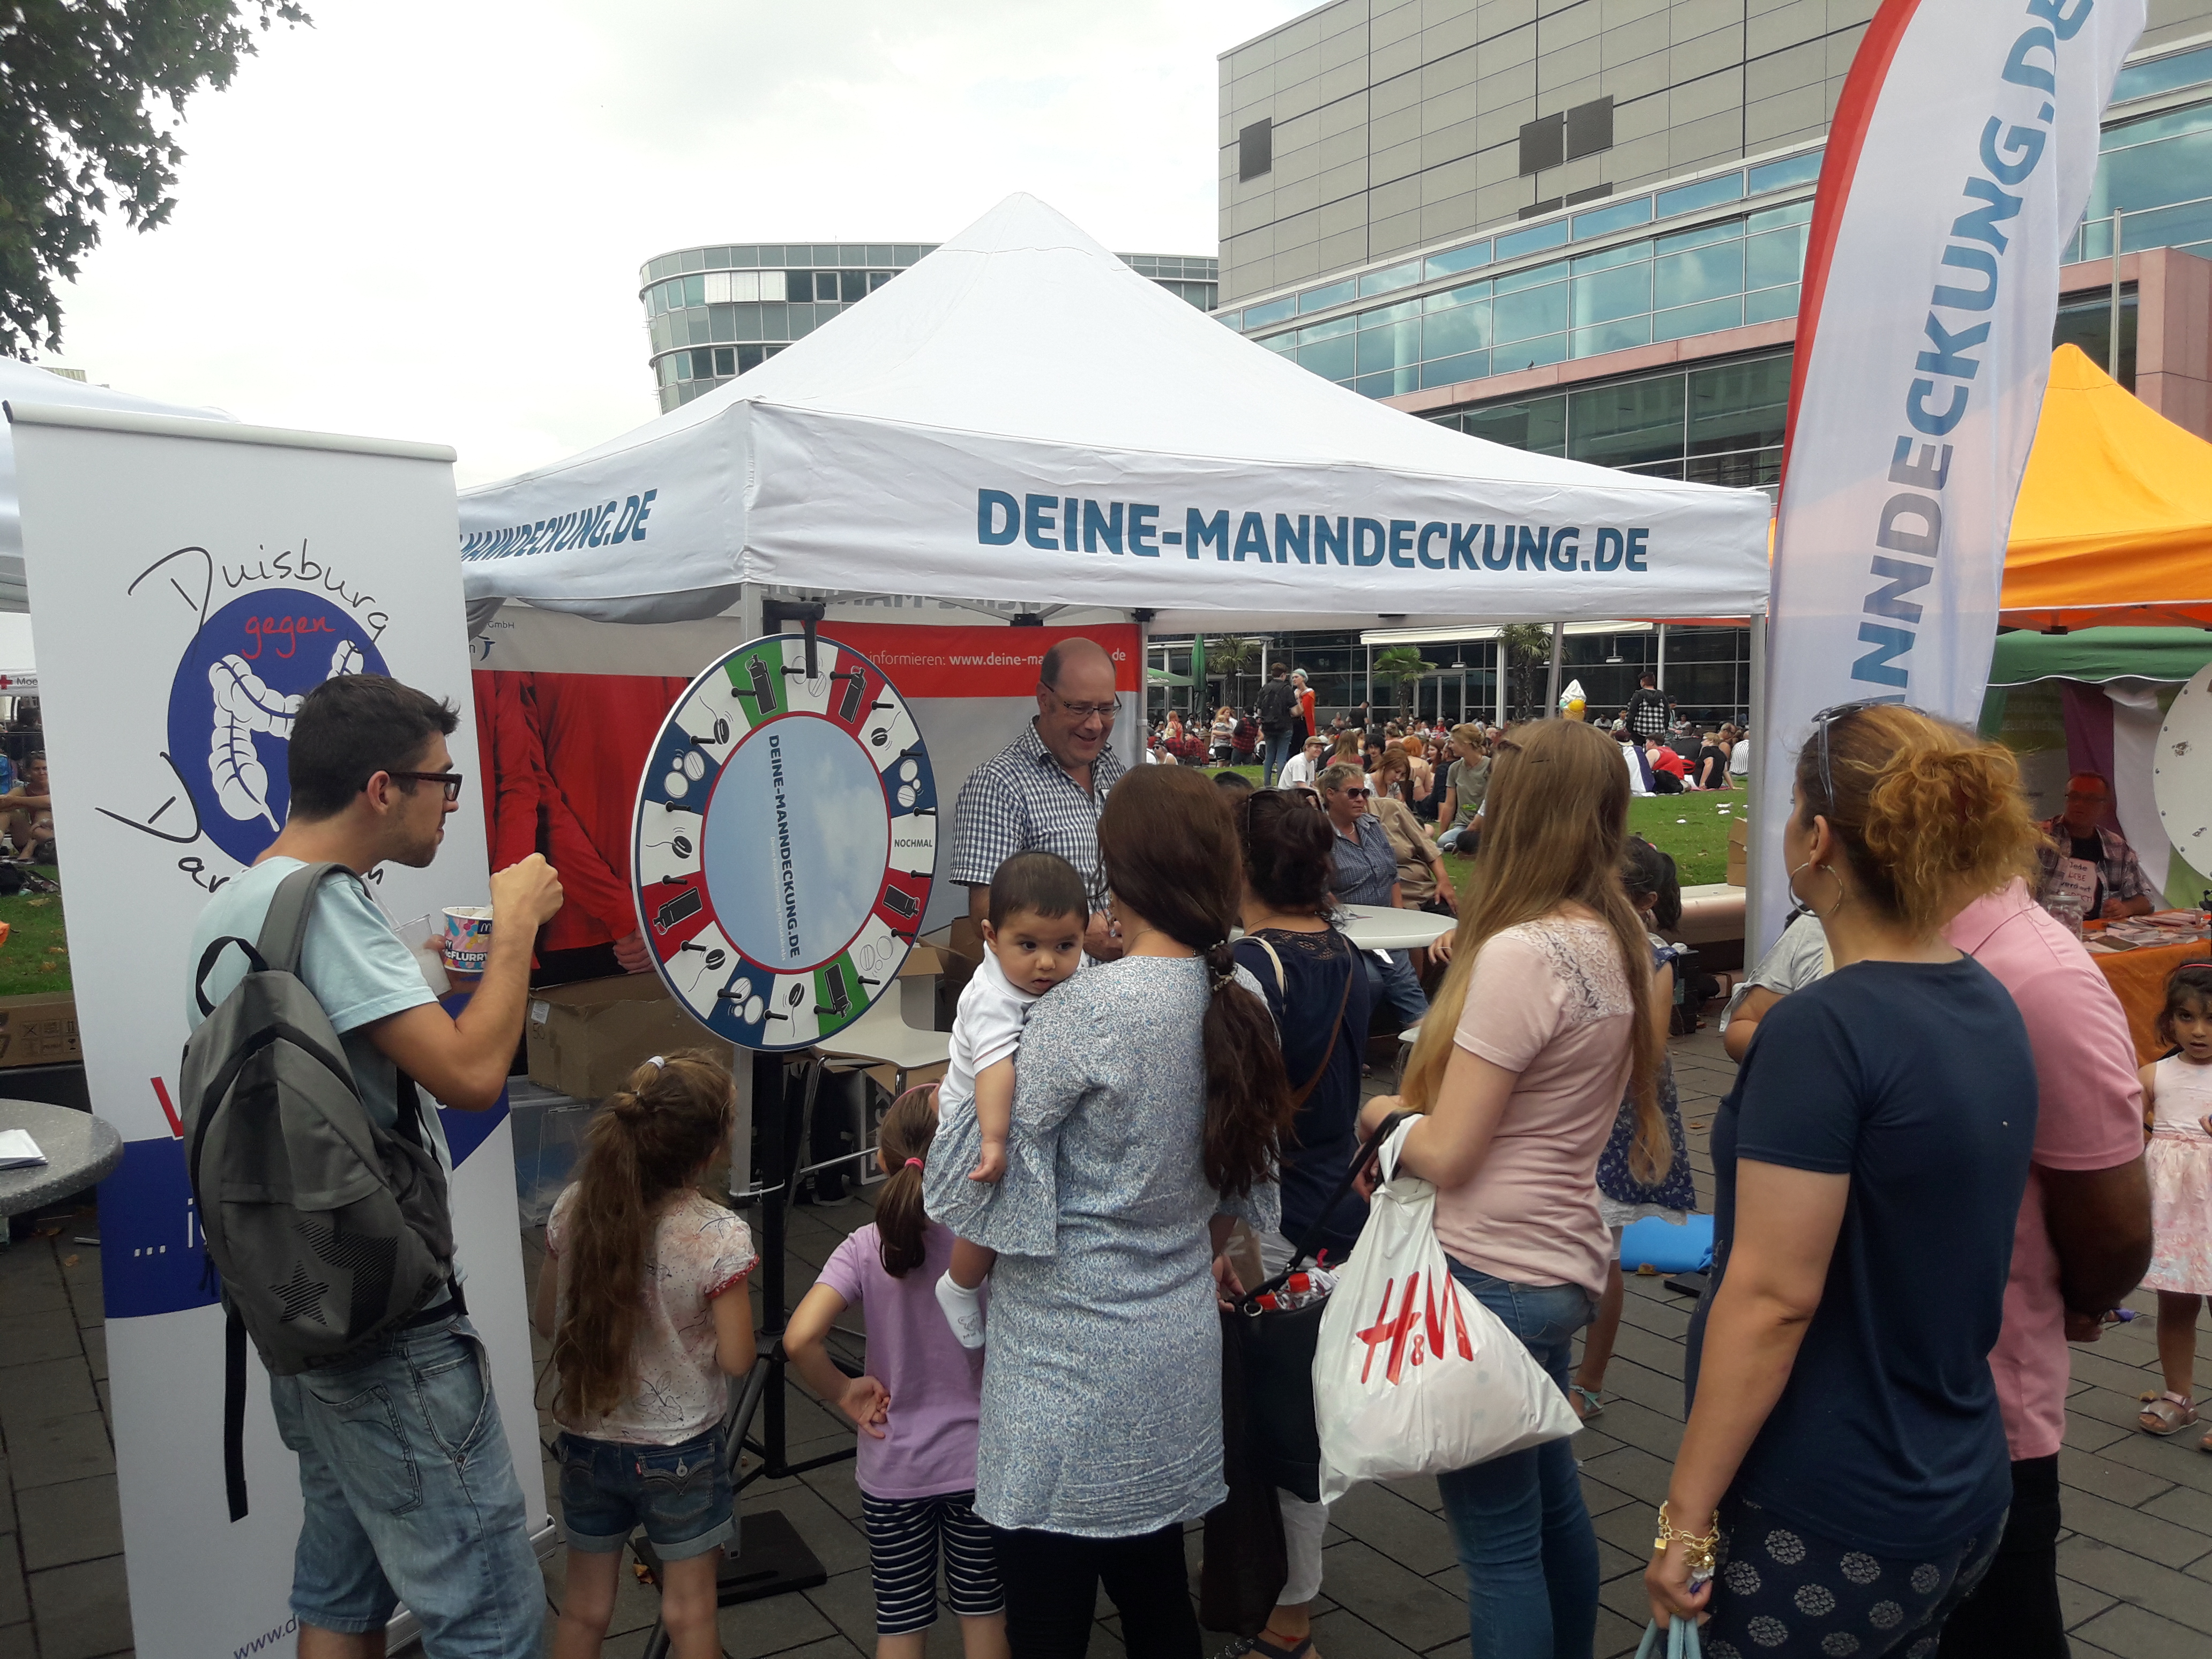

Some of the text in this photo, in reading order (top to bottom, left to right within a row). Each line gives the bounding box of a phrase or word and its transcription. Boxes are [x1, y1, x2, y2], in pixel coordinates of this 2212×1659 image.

[977, 488, 1650, 572] DEINE-MANNDECKUNG.DE
[128, 538, 389, 662] Duisburg
[241, 616, 336, 659] gegen
[768, 735, 800, 958] DEINE-MANNDECKUNG.DE
[894, 838, 933, 849] NOCHMAL
[1355, 1264, 1474, 1386] H&M
